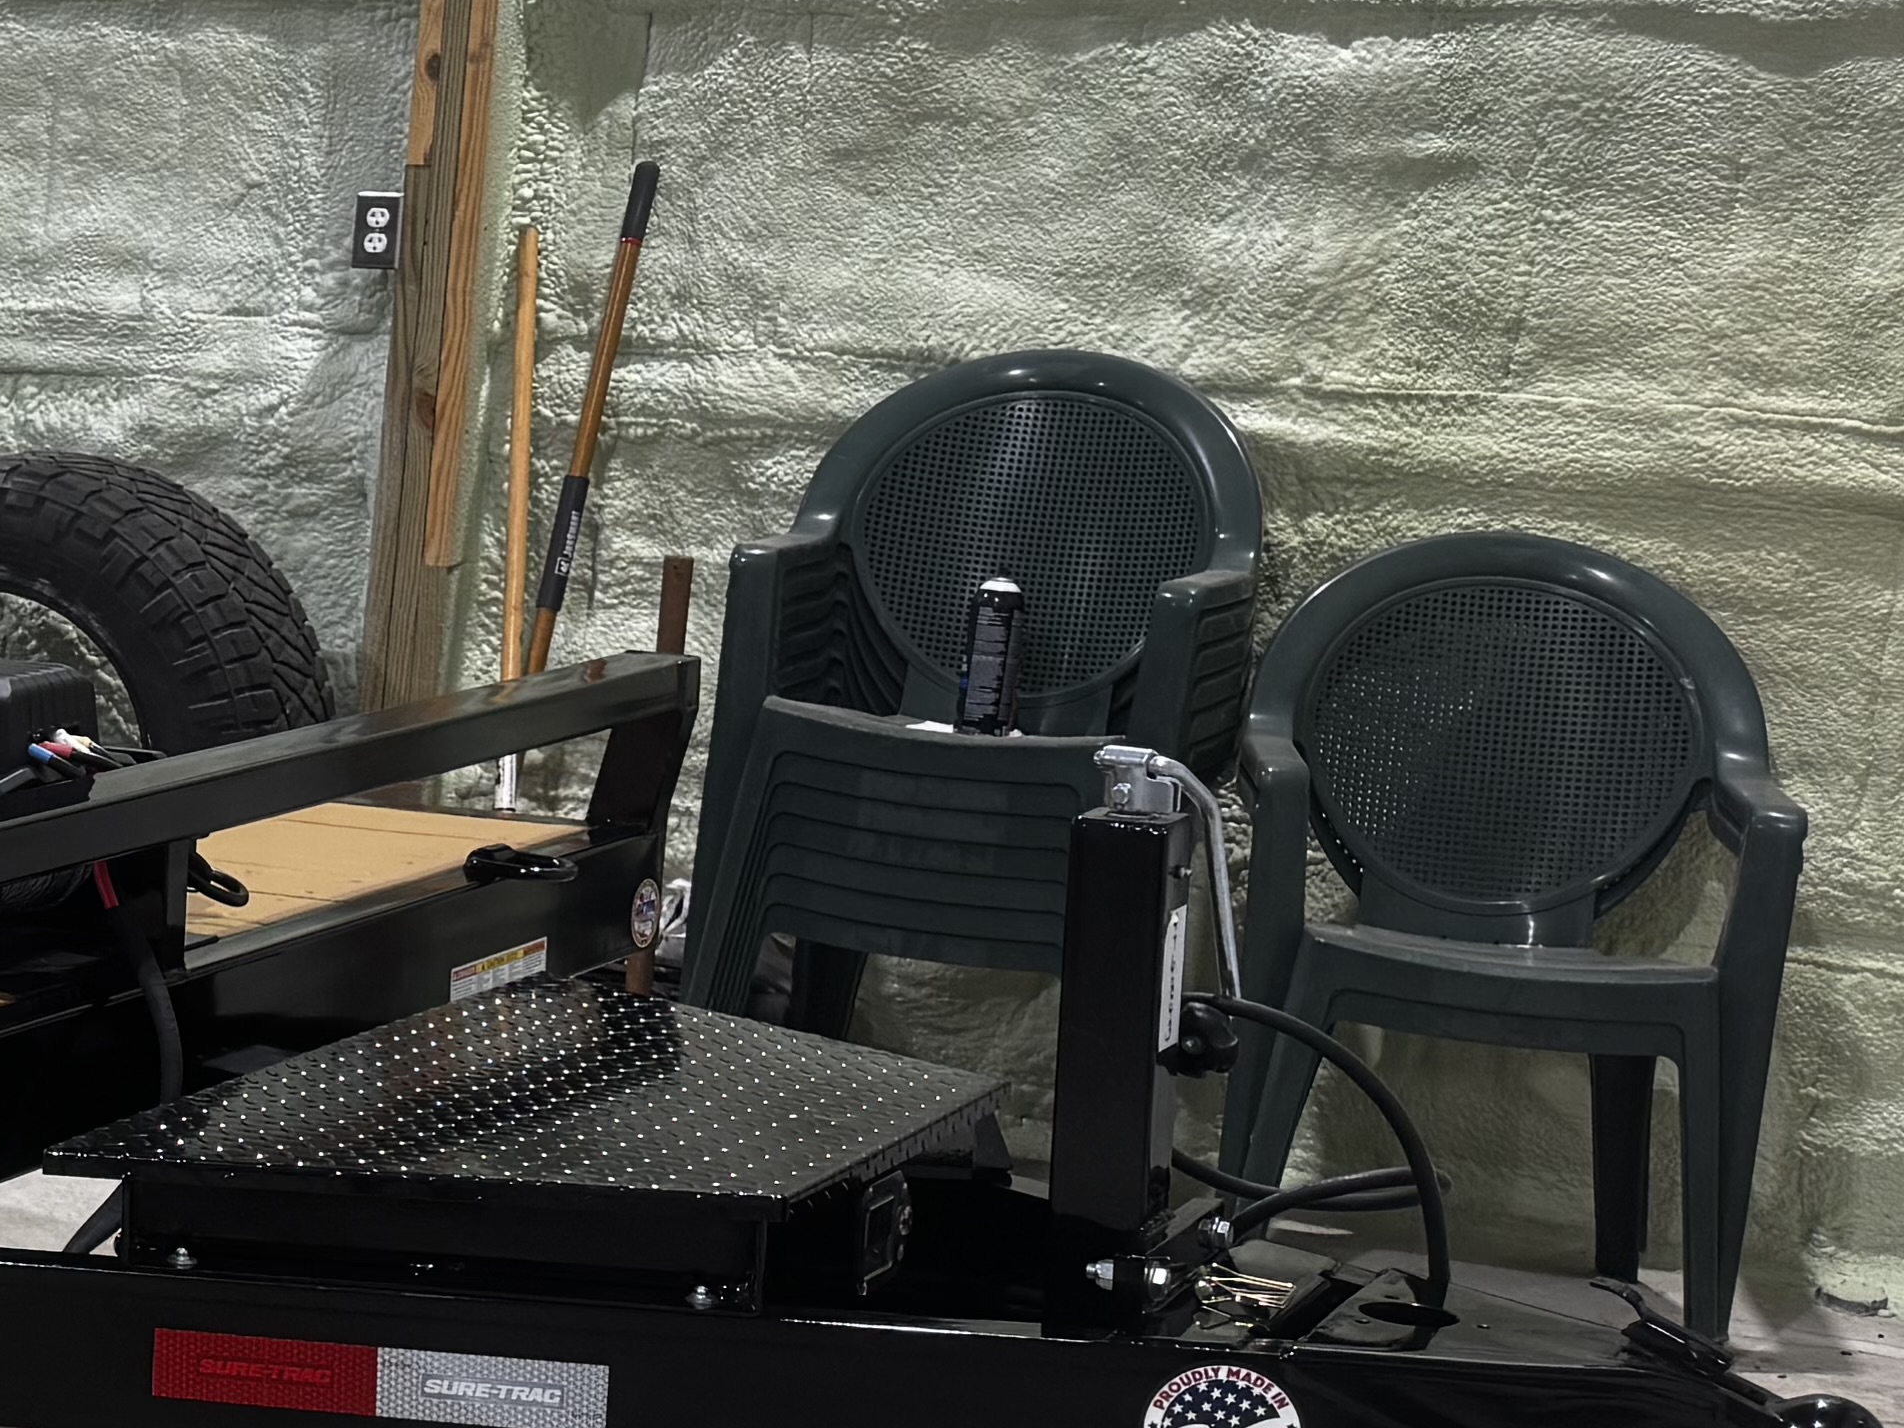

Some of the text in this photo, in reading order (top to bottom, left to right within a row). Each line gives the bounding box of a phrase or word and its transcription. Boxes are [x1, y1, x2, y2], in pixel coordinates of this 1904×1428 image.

[198, 1358, 563, 1405] SURE-TRAC SURE-TRAC
[1154, 1366, 1290, 1410] PROUDLY MADE IN
